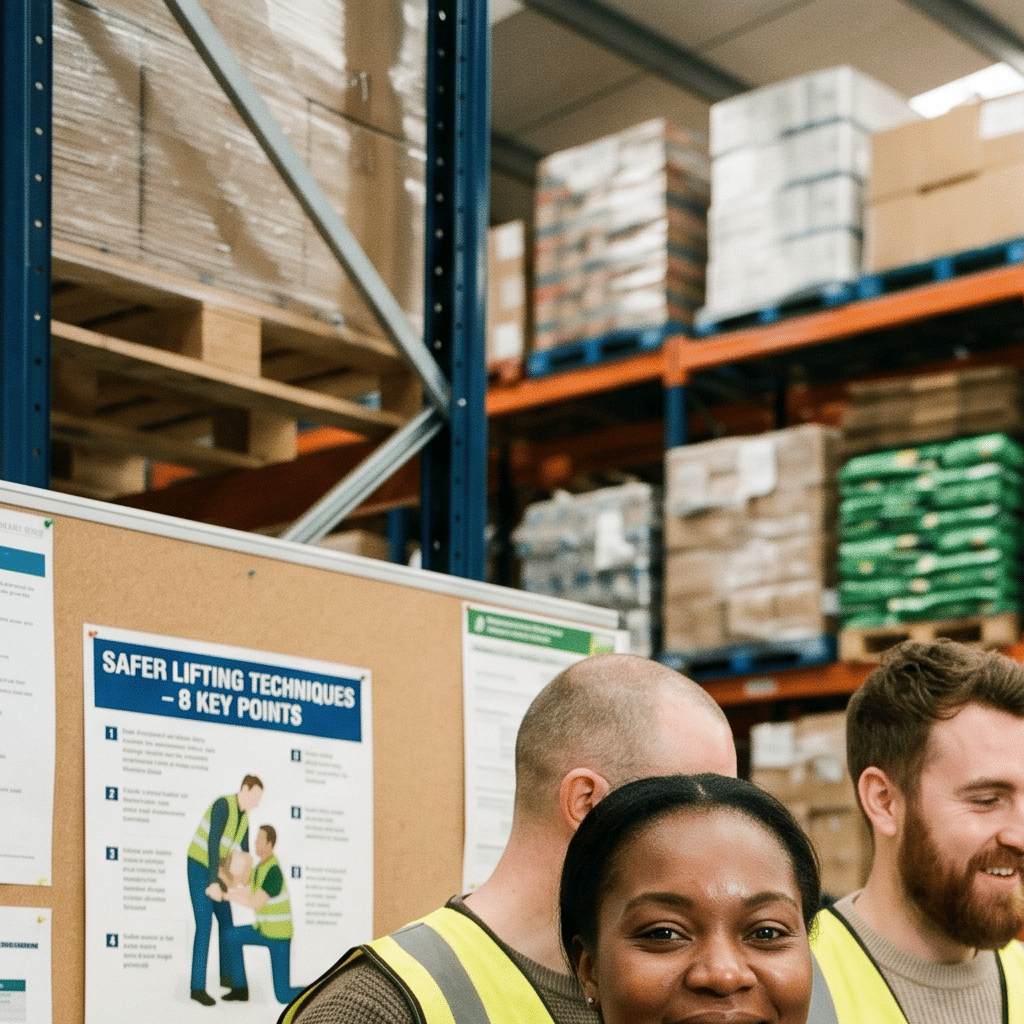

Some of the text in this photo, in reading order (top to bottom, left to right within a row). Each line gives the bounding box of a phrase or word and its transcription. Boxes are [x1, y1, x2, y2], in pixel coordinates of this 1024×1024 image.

[102, 649, 356, 709] SAFER LIFTING TECHNIQUES
[178, 688, 192, 711] 8
[195, 690, 233, 717] KEY
[237, 696, 303, 727] POINTS
